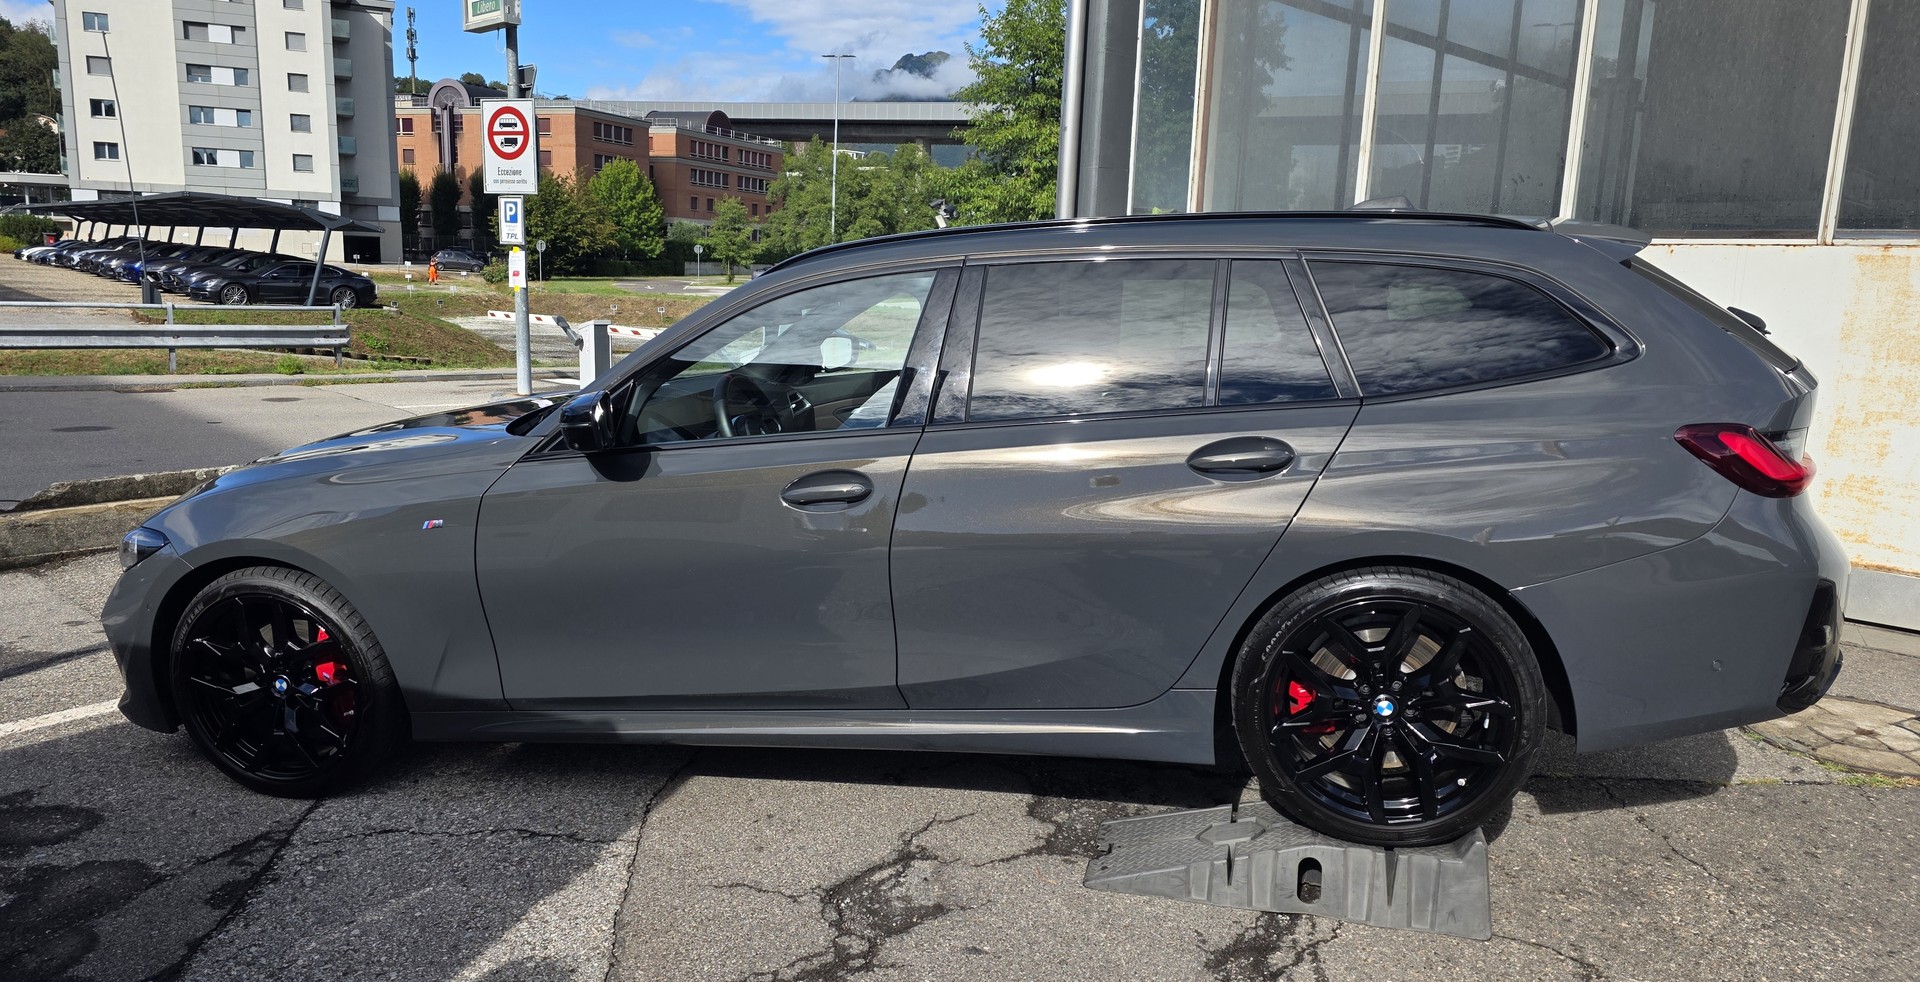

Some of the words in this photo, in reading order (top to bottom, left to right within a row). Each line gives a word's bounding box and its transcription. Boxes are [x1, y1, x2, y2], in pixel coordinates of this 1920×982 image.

[477, 0, 496, 13] Libero
[497, 166, 522, 176] Eccezione
[506, 203, 516, 221] P
